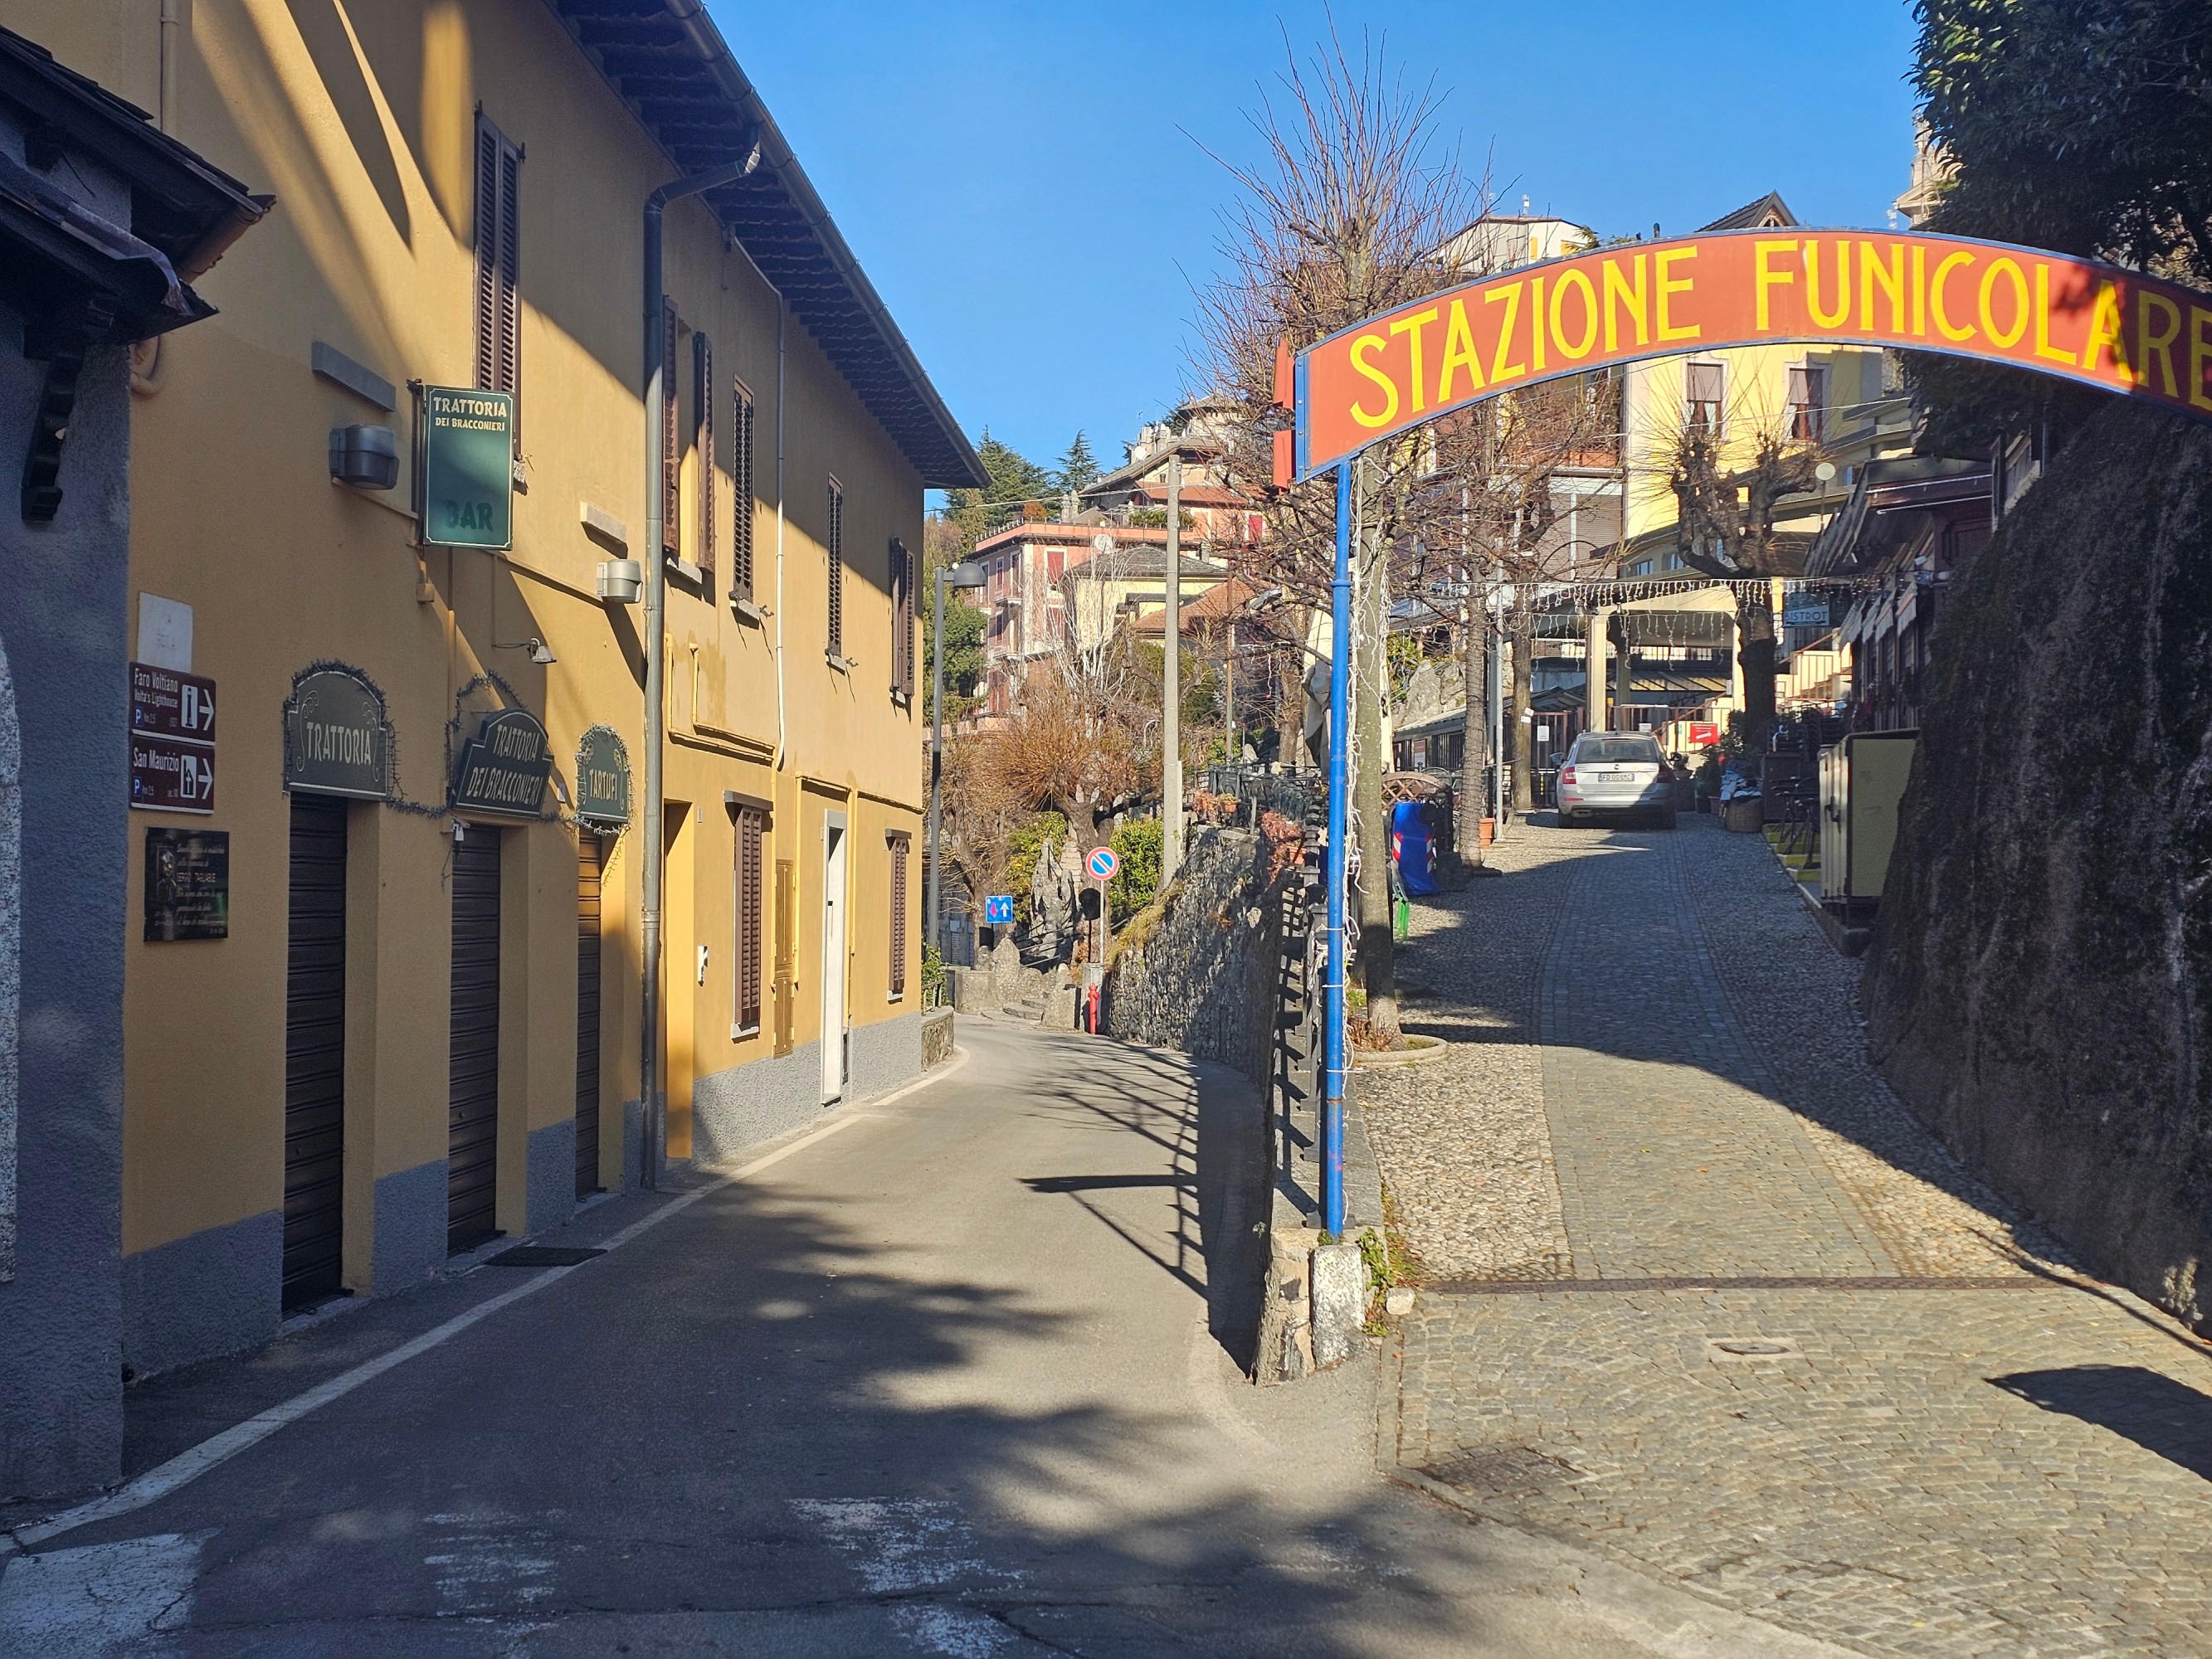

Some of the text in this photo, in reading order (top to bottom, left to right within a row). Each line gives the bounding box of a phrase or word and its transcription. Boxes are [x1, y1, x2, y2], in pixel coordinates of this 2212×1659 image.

[1349, 239, 2212, 427] STAZIONE FUNICOLARE
[433, 397, 507, 417] TRATTORIA
[436, 417, 505, 431] DEI BRACCONIERI
[446, 499, 494, 533] BAR
[1785, 611, 1827, 620] BISTROT
[134, 668, 178, 693] Faro Voltiano
[134, 688, 178, 708] Volta's Lighthouse
[135, 708, 141, 724] P
[307, 722, 371, 766] TRATTORIA
[494, 724, 539, 762] TRATTORIA
[134, 747, 179, 771] San Maurizio
[134, 779, 140, 794] P
[466, 766, 543, 805] DEI BRACCONIERI
[589, 768, 617, 800] TARTUFI
